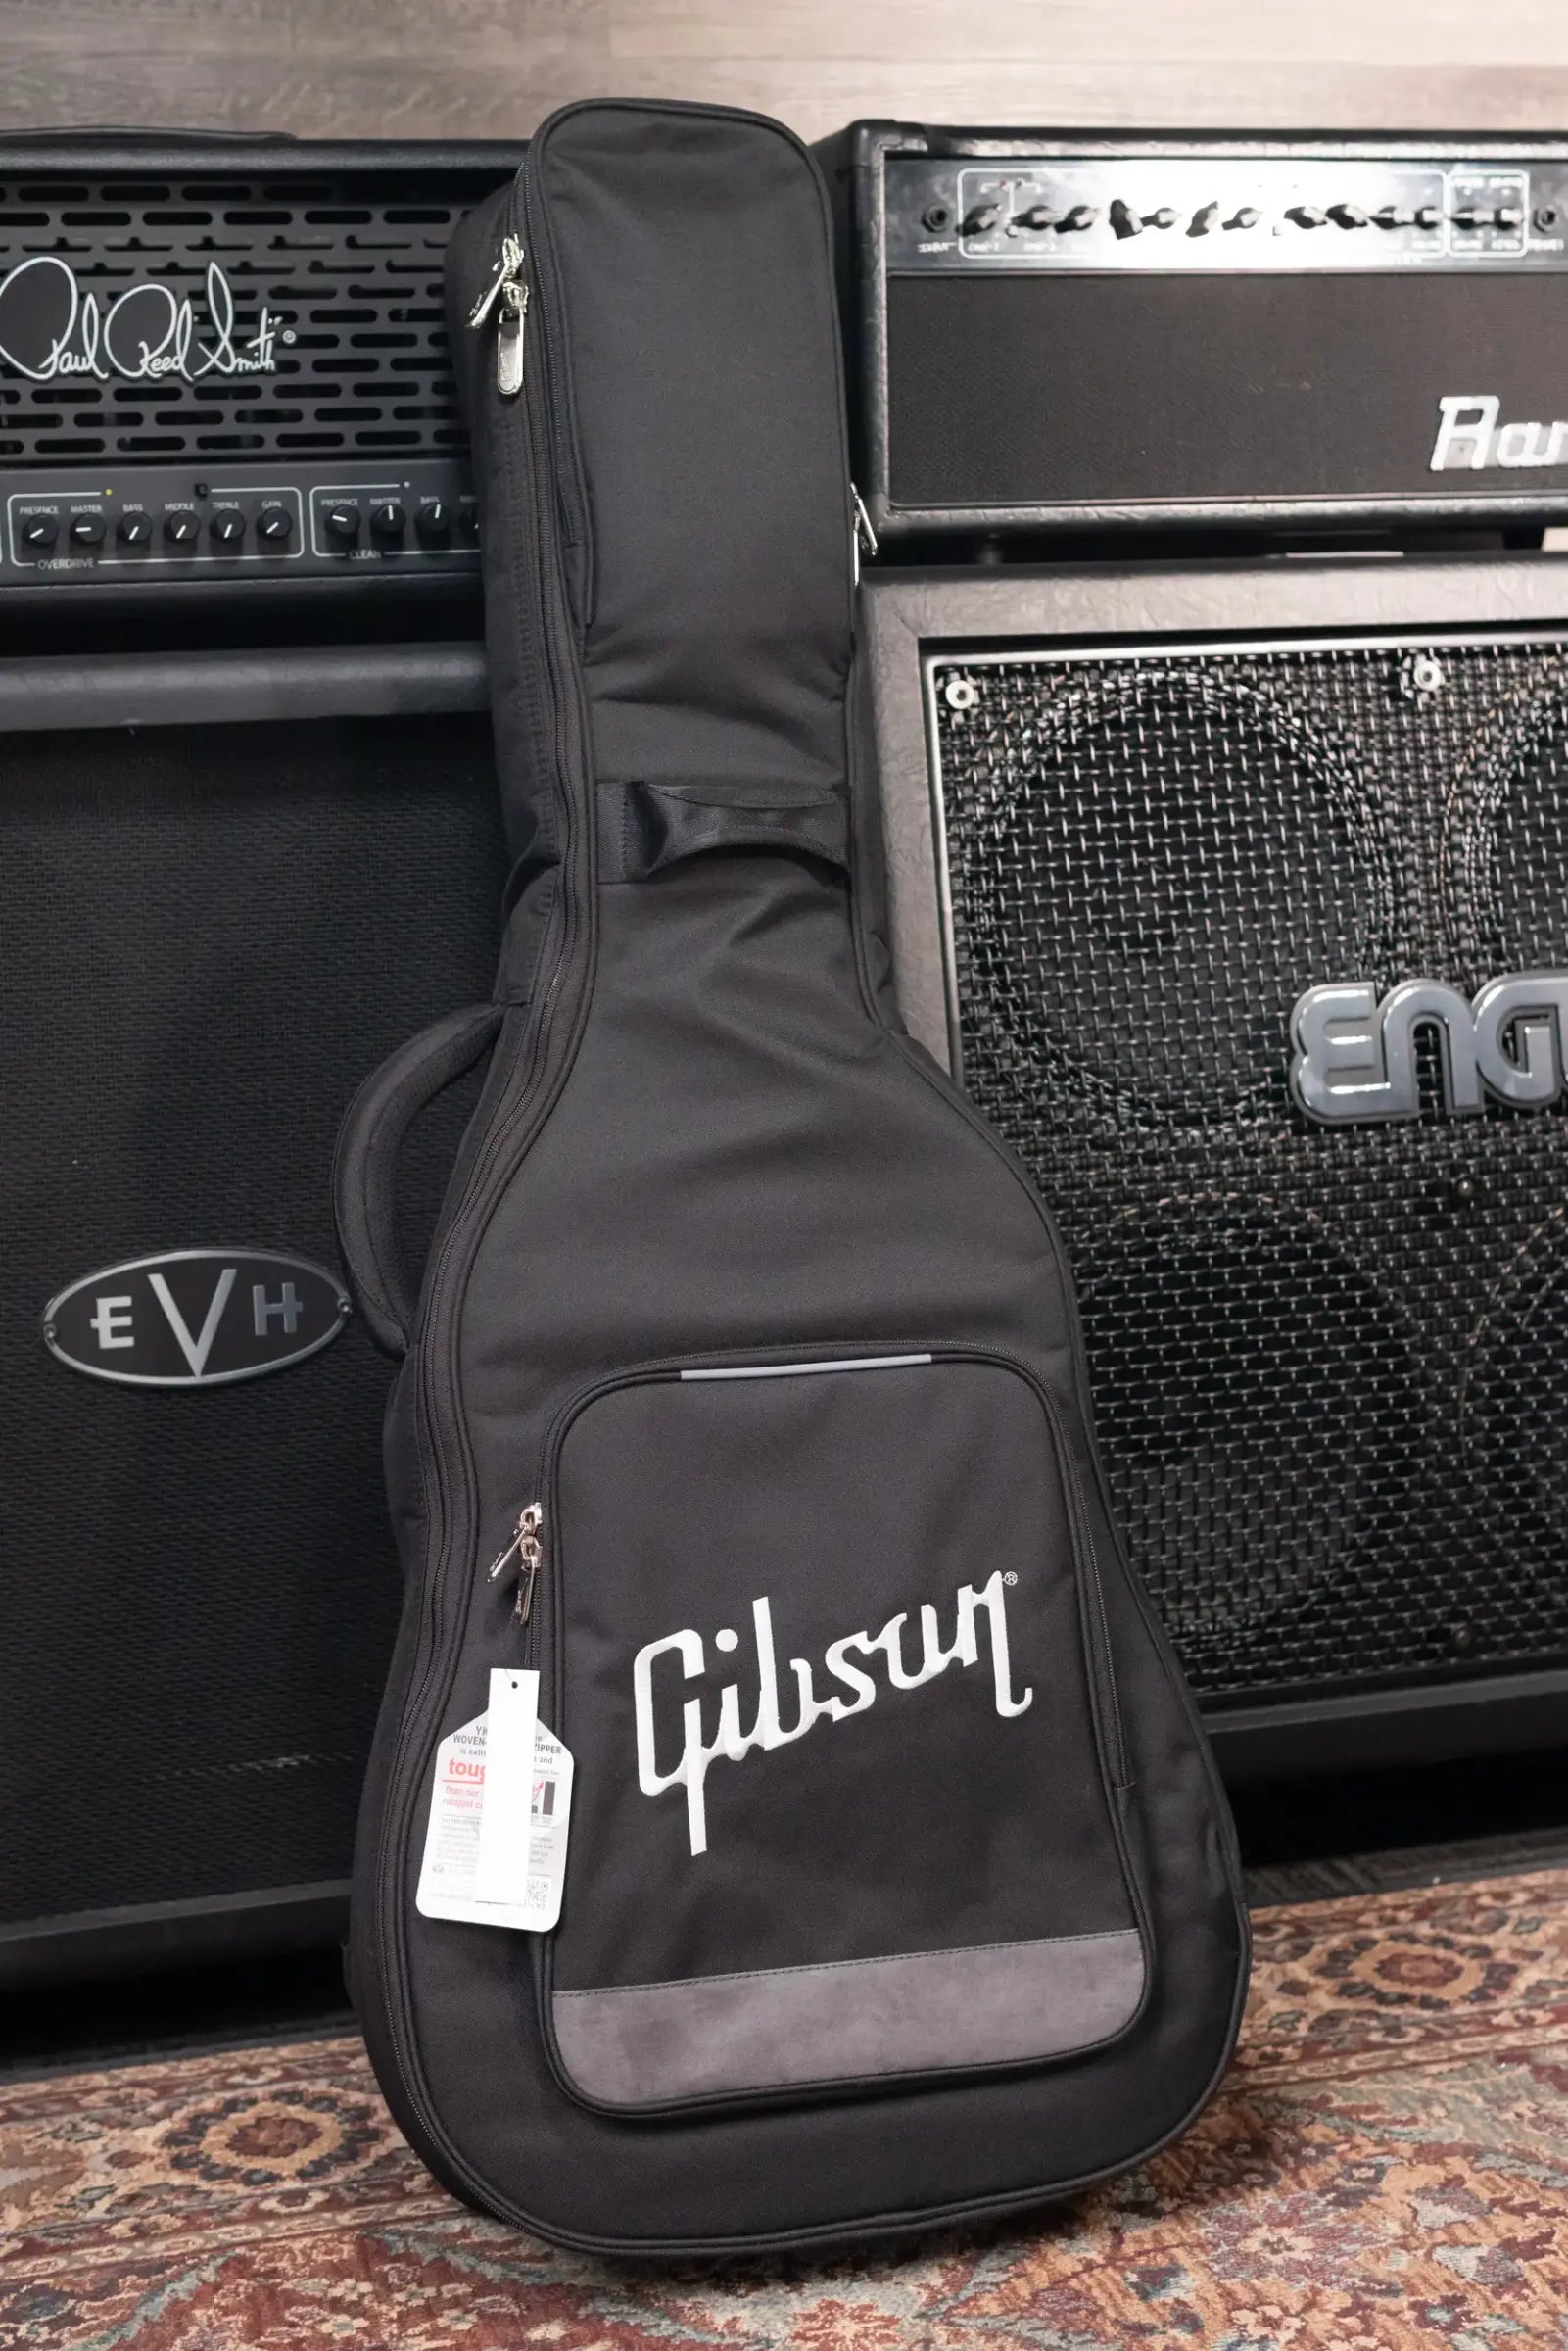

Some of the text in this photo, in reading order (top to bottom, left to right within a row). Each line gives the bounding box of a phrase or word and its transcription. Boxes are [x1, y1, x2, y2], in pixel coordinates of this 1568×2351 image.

[0, 256, 283, 382] Paul Reed Smith
[20, 500, 282, 515] PRESENCE MASTER BASS MIDDLE TREBLE GAIN
[321, 497, 358, 506] PRESENCE
[369, 496, 401, 505] MASTER
[420, 495, 440, 504] BASS
[350, 549, 382, 559] CLEAN
[37, 557, 95, 570] OVERDRIVE
[1290, 971, 1568, 1124] ENG
[90, 1269, 304, 1378] EVH
[634, 1570, 1033, 1857] Gibson
[539, 1756, 553, 1765] and
